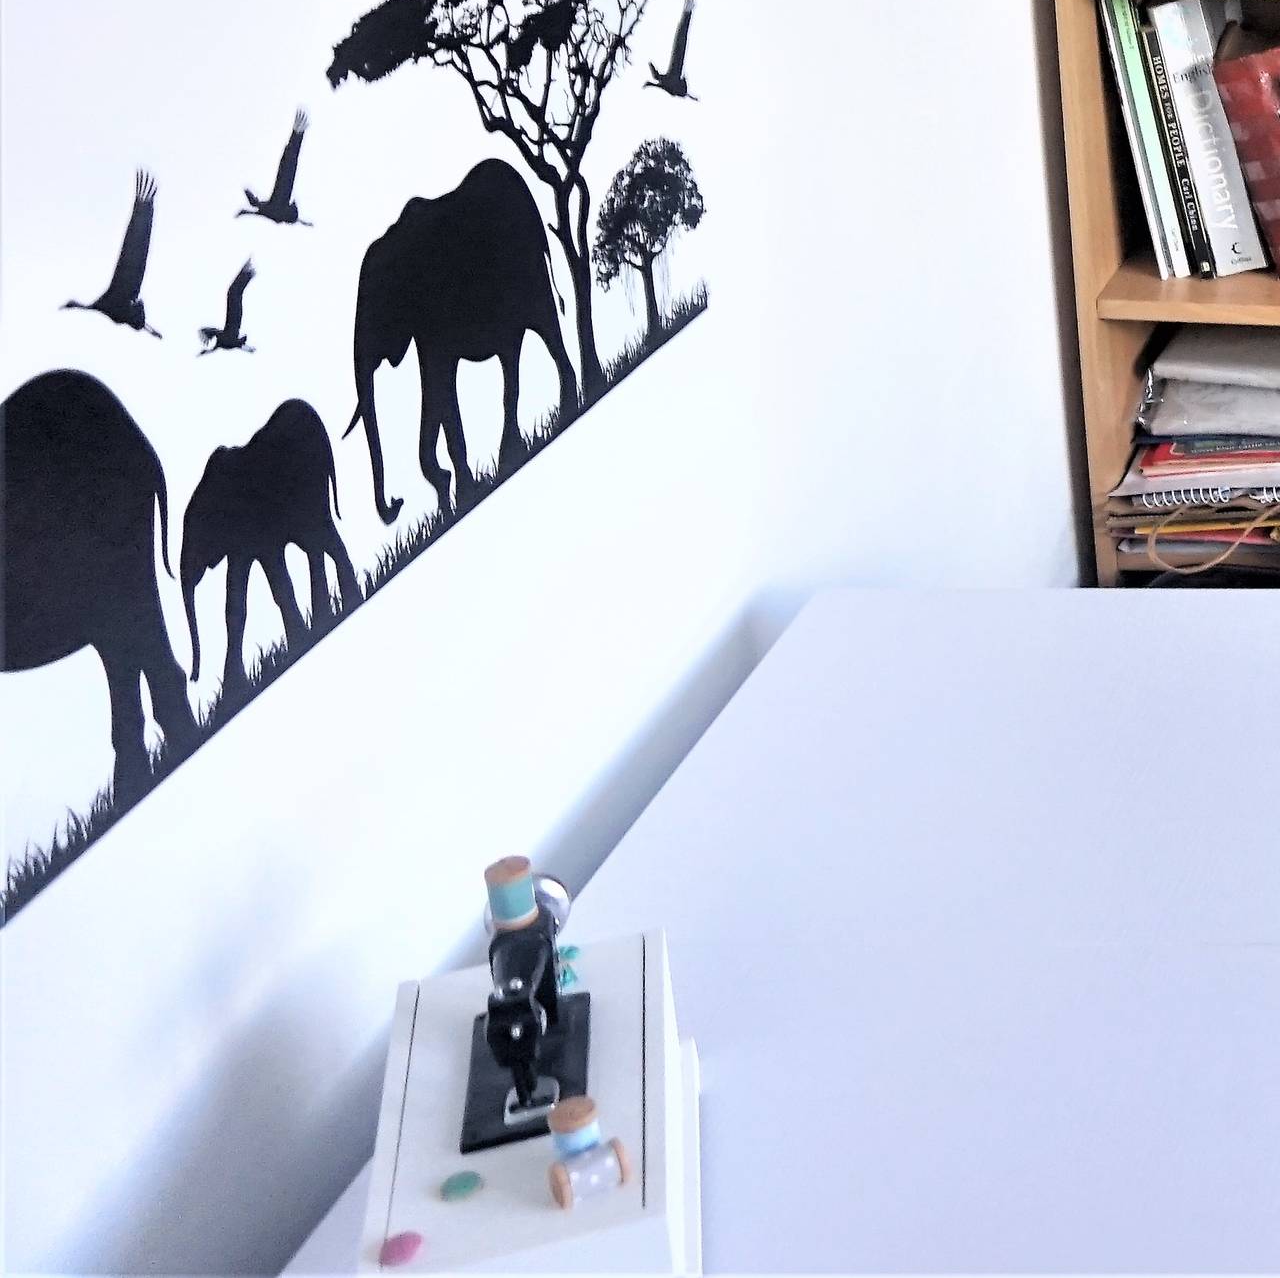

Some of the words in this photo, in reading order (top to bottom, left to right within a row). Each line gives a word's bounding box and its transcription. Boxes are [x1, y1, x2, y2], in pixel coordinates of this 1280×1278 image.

[1152, 55, 1169, 100] HOMES
[1167, 120, 1185, 167] PEOPLE
[1188, 89, 1239, 231] Dictionary
[1181, 178, 1191, 199] Carl
[1185, 200, 1198, 232] Chinn
